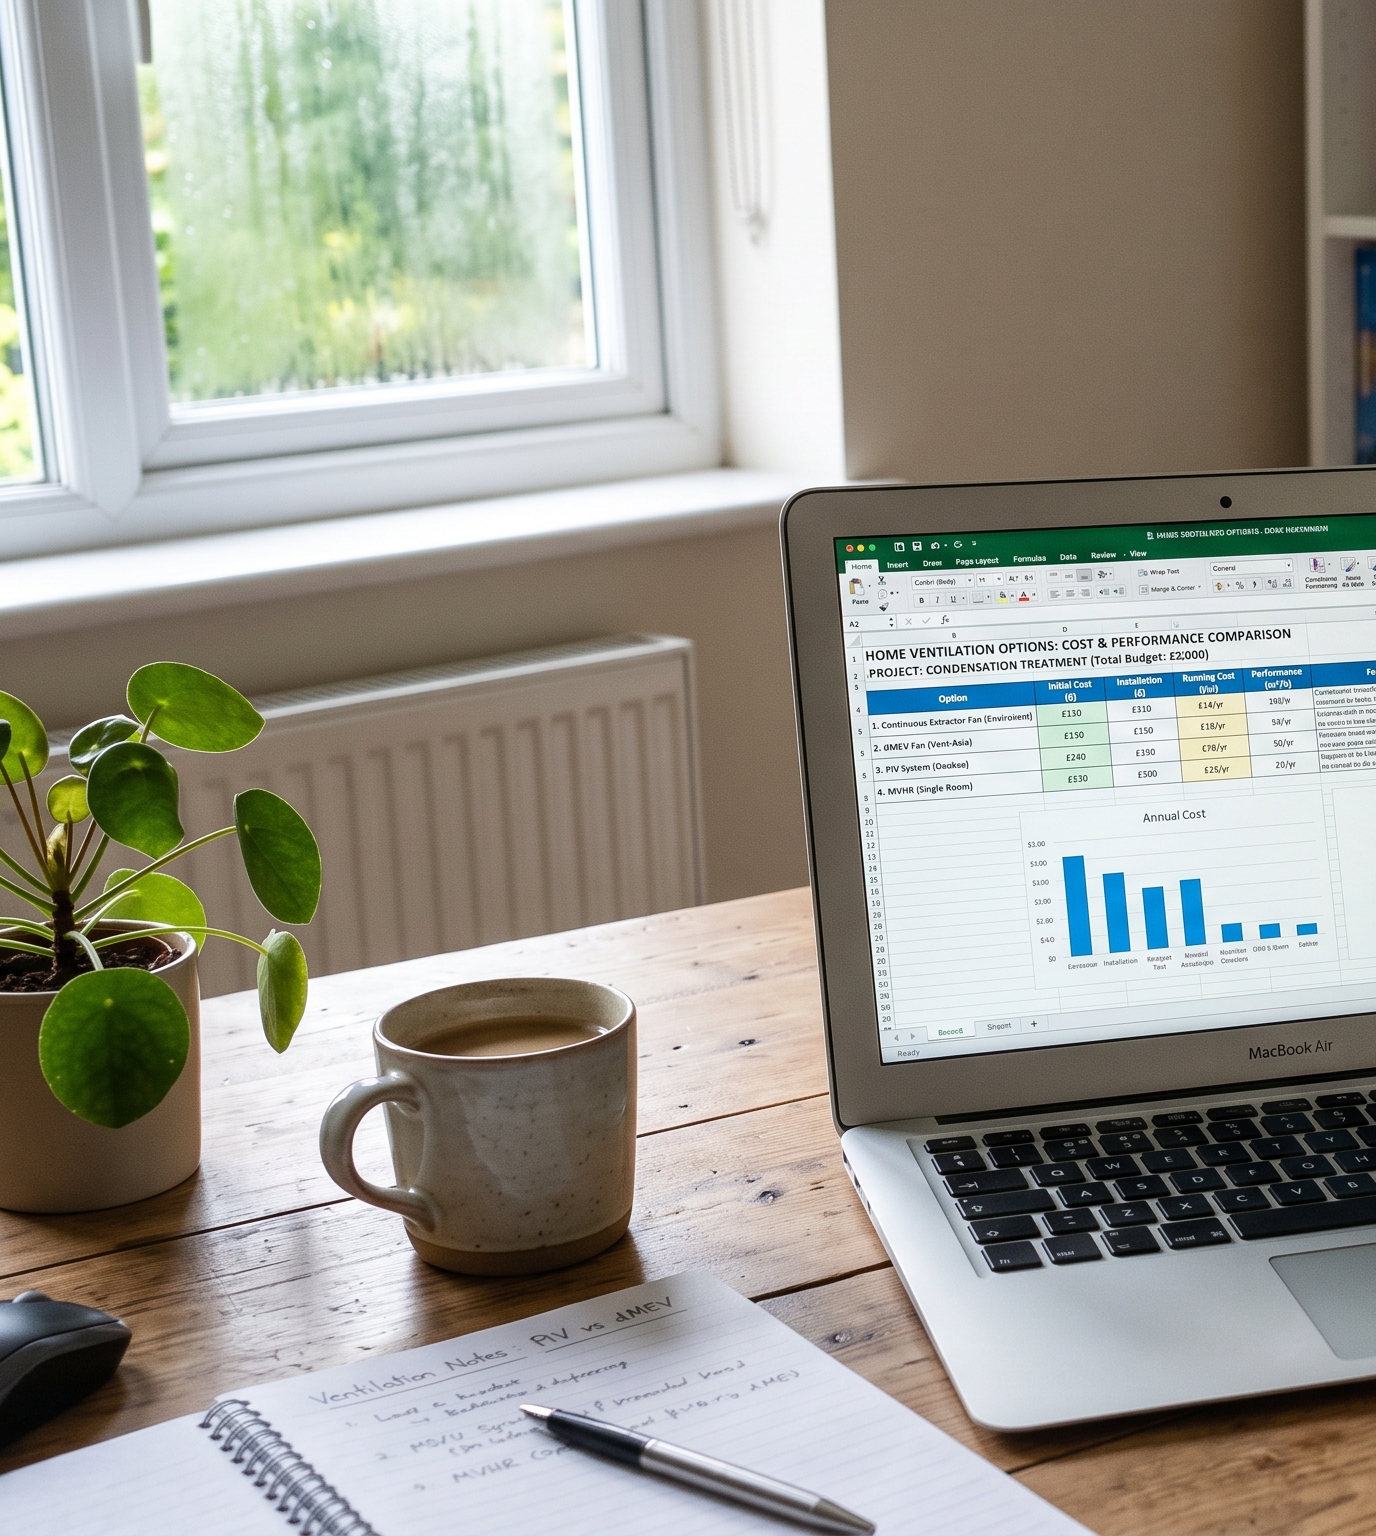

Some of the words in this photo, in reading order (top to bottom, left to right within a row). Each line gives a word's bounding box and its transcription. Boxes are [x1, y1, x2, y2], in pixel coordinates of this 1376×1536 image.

[1091, 551, 1117, 559] Review
[1129, 550, 1147, 558] View
[866, 649, 906, 662] HOME
[910, 644, 995, 659] VENTILATION
[999, 641, 1058, 654] OPTIONS:
[1062, 638, 1094, 650] COST
[1098, 637, 1108, 648] &
[1111, 633, 1205, 647] PERFORMANCE
[1207, 628, 1292, 643] COMPARISON
[869, 666, 923, 679] PROJECT:
[926, 661, 1018, 675] CONDENSATION
[1020, 656, 1087, 670] TREATMENT
[1091, 654, 1122, 668] (Total
[1125, 652, 1167, 665] Budget:
[1183, 673, 1215, 683] Running
[1217, 672, 1235, 680] Cost
[1048, 681, 1072, 691] Initial
[1073, 680, 1092, 689] Cost
[938, 694, 968, 704] Option
[1132, 705, 1152, 714] £310
[1198, 701, 1224, 710] £14/yr
[1062, 710, 1082, 718] £130
[872, 722, 880, 730] 1.
[881, 719, 928, 730] Continuous
[930, 717, 966, 726] Extractor
[968, 716, 982, 724] Fan
[1201, 722, 1226, 731] £18/yr
[1064, 731, 1085, 740] £150
[1134, 727, 1154, 735] £150
[911, 742, 926, 750] Fan
[927, 738, 973, 749] (Vent-Asia)
[1066, 753, 1087, 761] £240
[1136, 748, 1156, 757] £390
[875, 766, 884, 774] 3.
[885, 765, 900, 773] PIV
[901, 763, 931, 773] System
[1138, 770, 1158, 778] £500
[1068, 775, 1088, 783] £530
[887, 786, 915, 795] MVHR
[916, 783, 944, 795] (Single
[945, 782, 973, 792] Room)
[1143, 810, 1180, 823] Annual
[1182, 809, 1206, 820] Cost
[897, 1049, 920, 1058] Ready
[1249, 1041, 1312, 1060] MacBook
[1315, 1039, 1333, 1053] Air
[1272, 1142, 1281, 1150] T
[1355, 1155, 1369, 1163] H
[1104, 1162, 1120, 1170] W
[1080, 1190, 1092, 1198] A
[1290, 1187, 1302, 1195] V
[1236, 1194, 1248, 1202] C
[1179, 1202, 1192, 1210] X
[1122, 1209, 1134, 1217] Z
[309, 1370, 437, 1406] Ventilation
[530, 1327, 570, 1347] PIV
[580, 1320, 605, 1332] vs
[615, 1296, 673, 1324] dMEV
